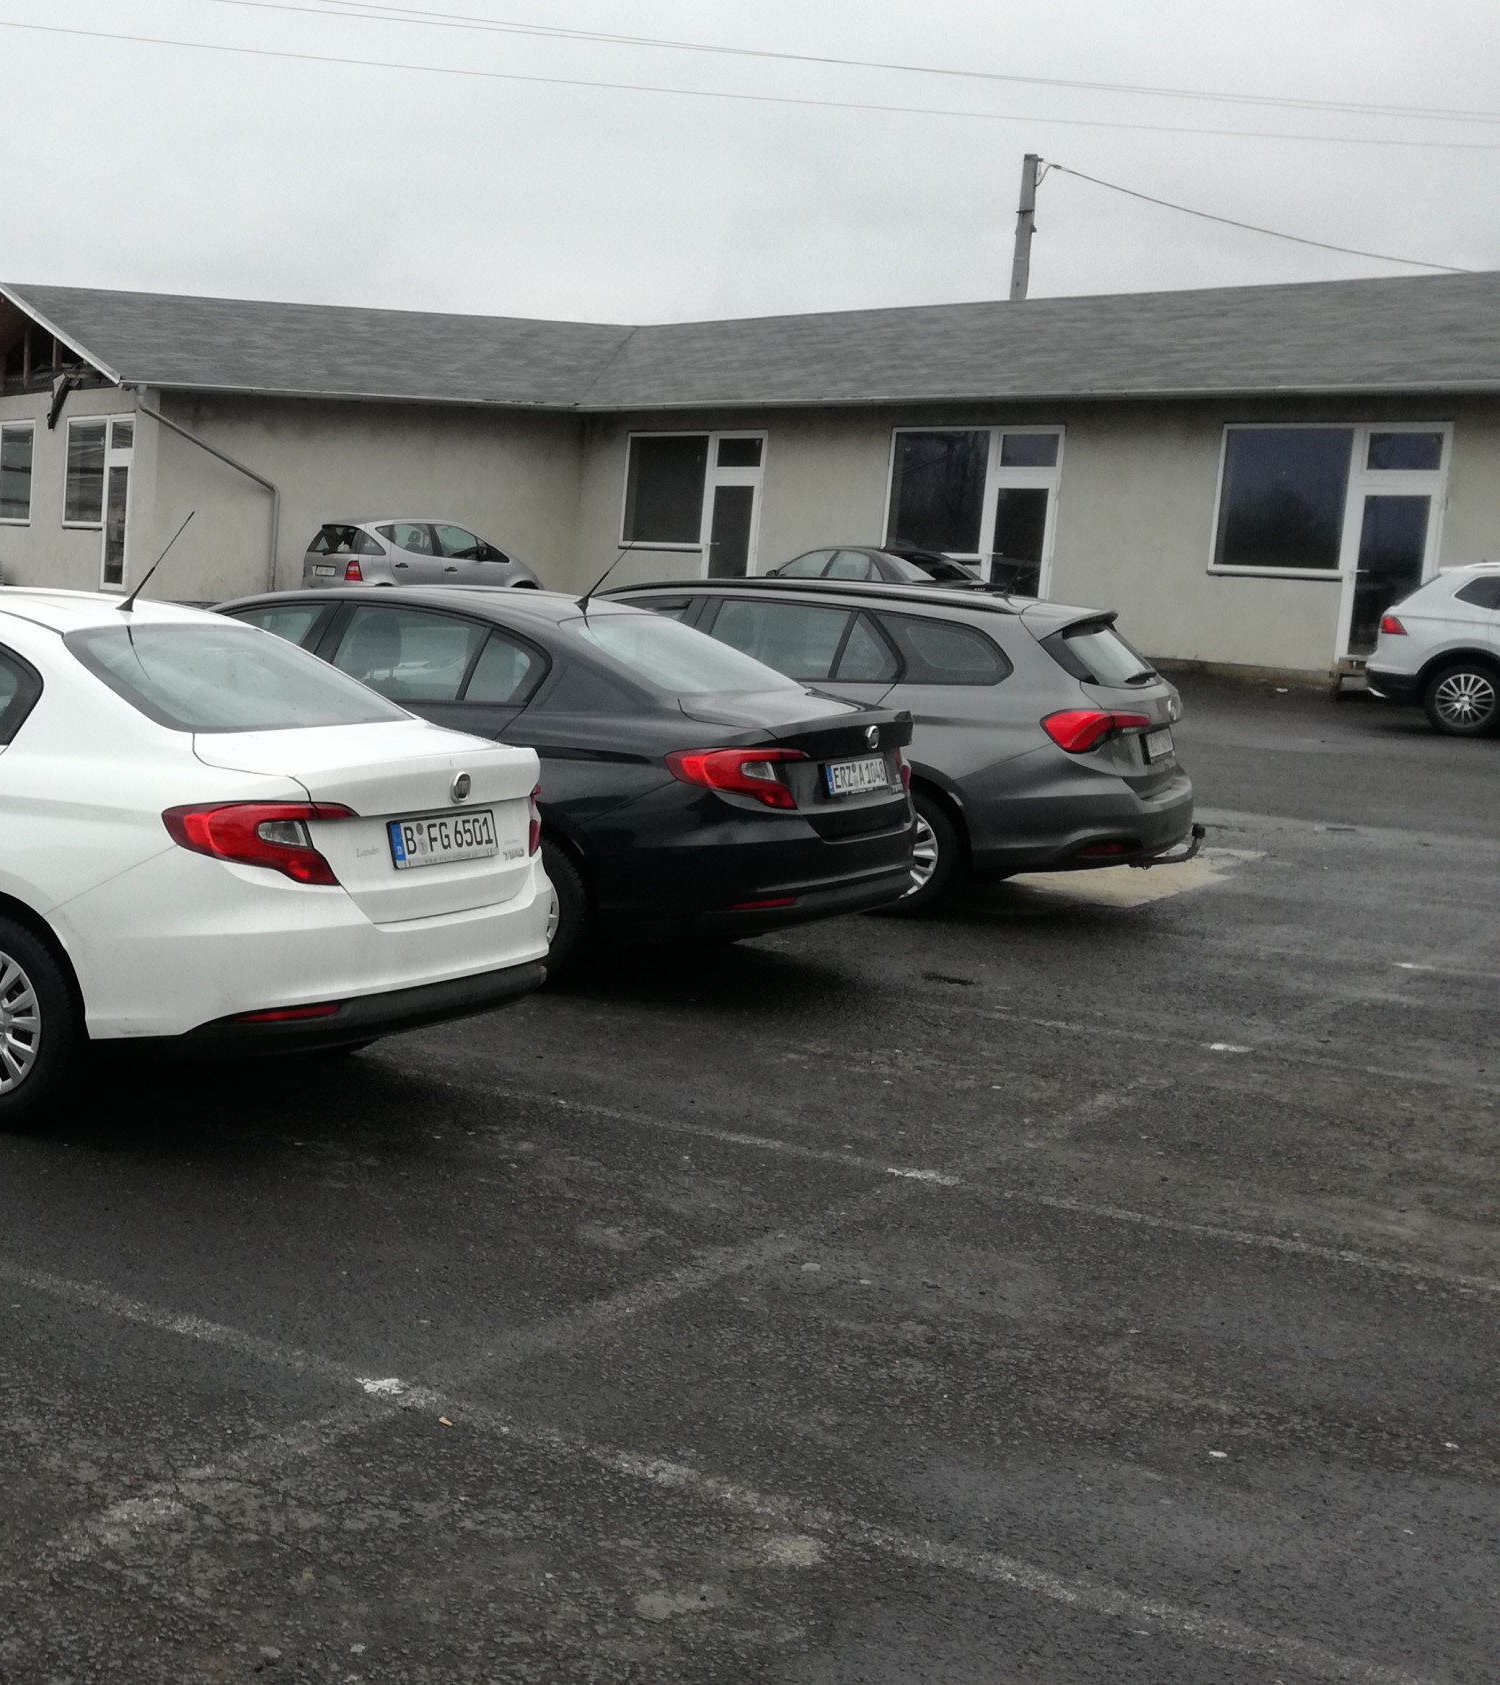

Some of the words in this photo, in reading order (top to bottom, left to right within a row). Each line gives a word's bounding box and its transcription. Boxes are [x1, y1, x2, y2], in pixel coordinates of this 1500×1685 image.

[833, 765, 854, 789] ERZ
[858, 763, 866, 786] A
[404, 826, 417, 855] B
[427, 822, 452, 853] FG
[454, 816, 493, 848] 6501
